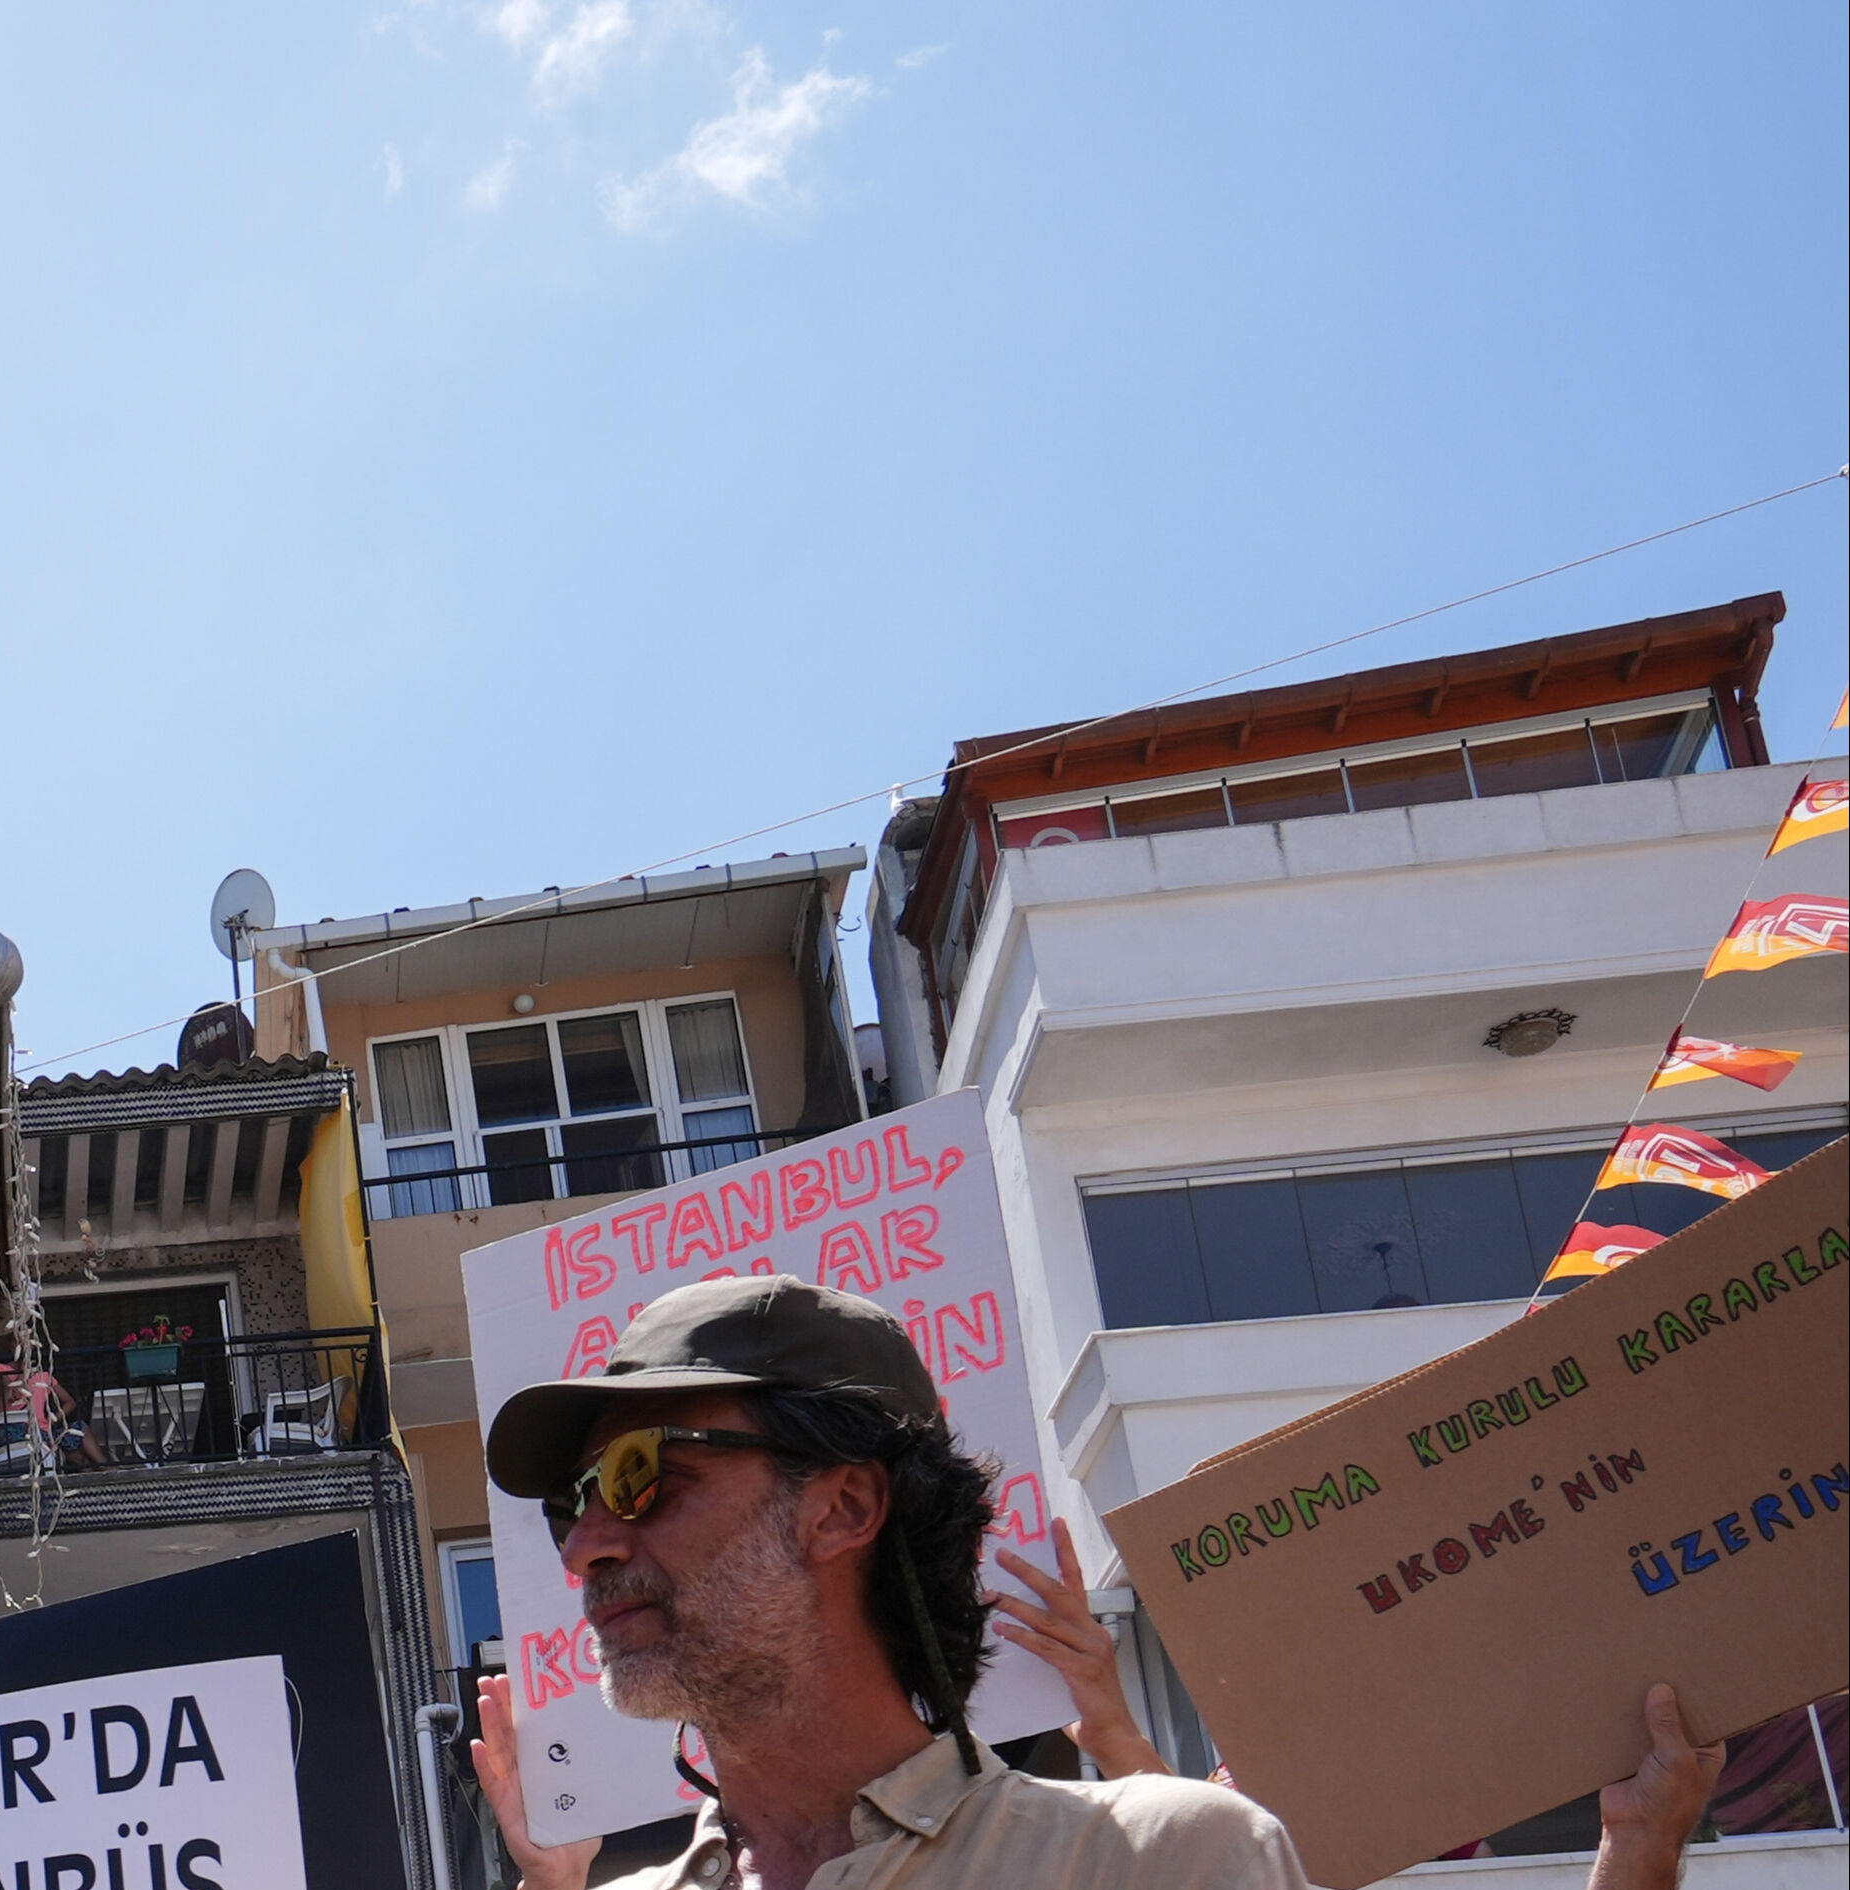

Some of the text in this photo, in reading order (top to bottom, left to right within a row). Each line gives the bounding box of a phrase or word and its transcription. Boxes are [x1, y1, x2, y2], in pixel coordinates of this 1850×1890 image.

[1171, 1464, 1380, 1582] KORUMA
[1408, 1355, 1588, 1468] KURULU
[1618, 1226, 1849, 1375] KARARLA
